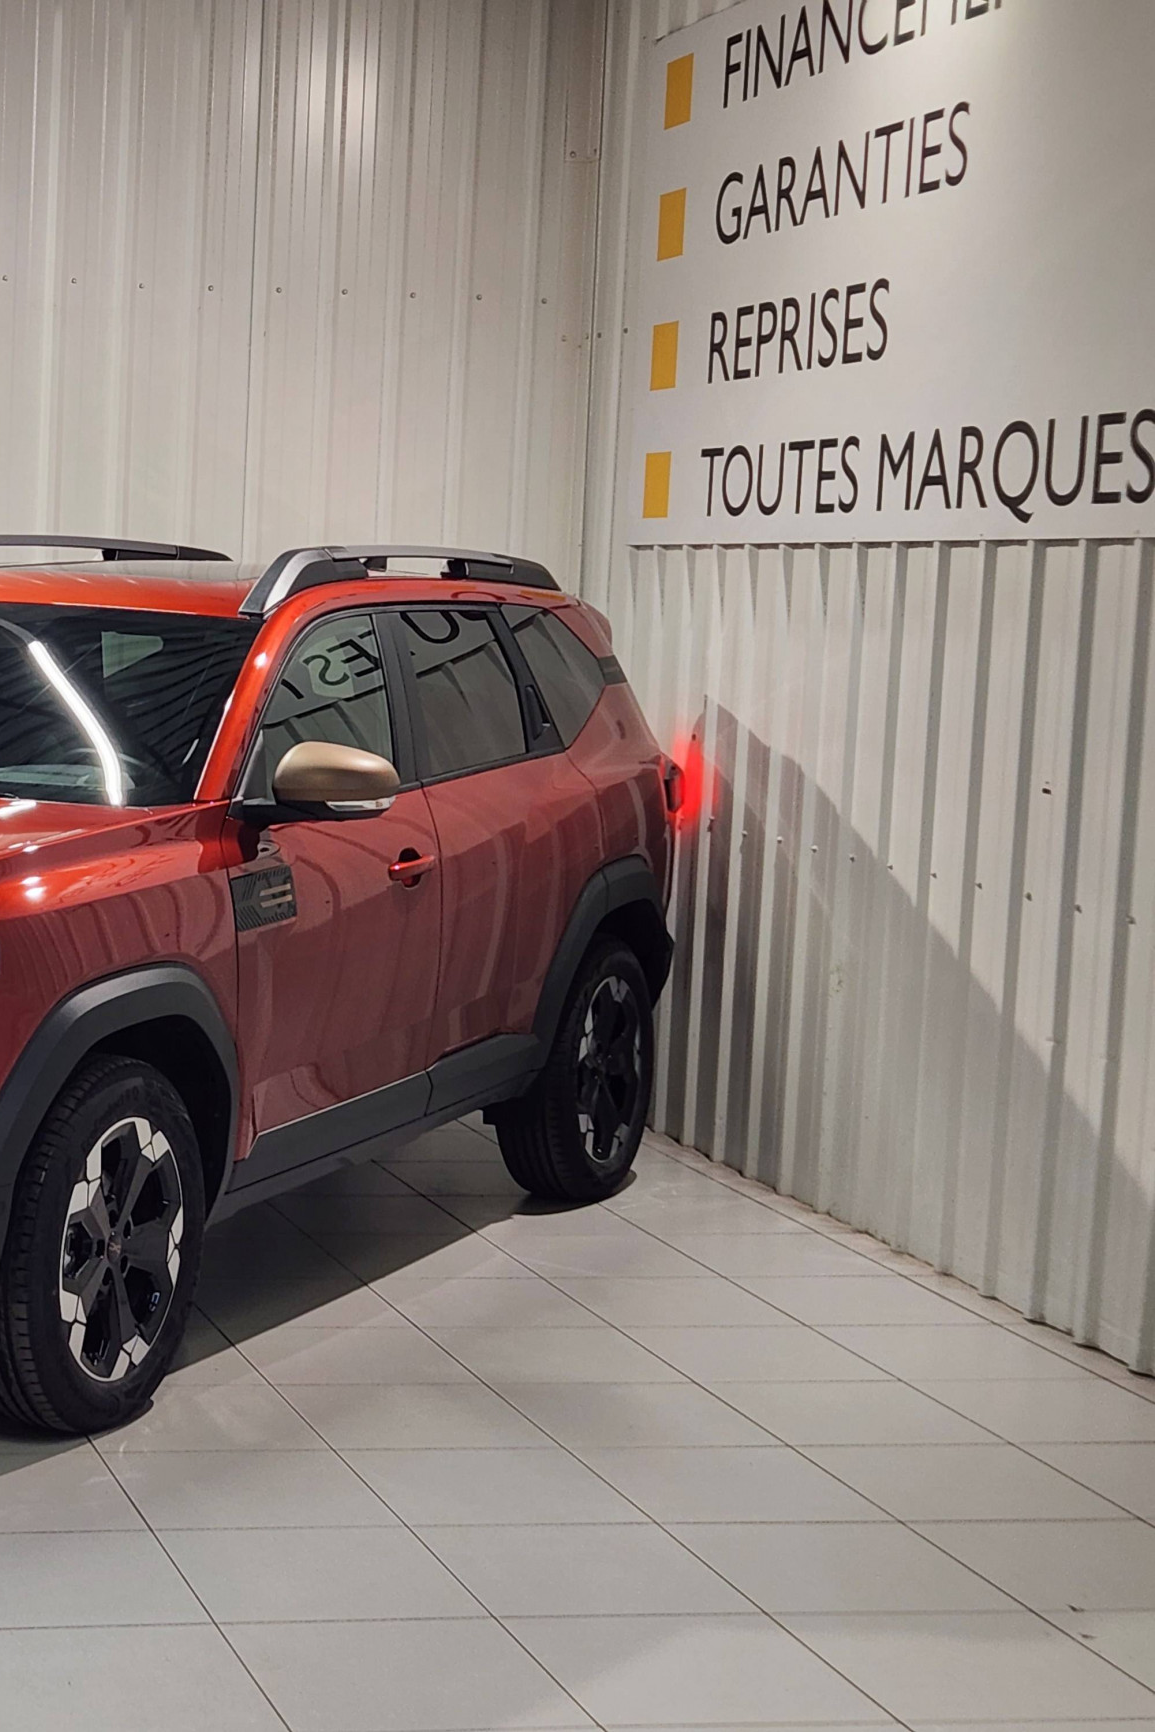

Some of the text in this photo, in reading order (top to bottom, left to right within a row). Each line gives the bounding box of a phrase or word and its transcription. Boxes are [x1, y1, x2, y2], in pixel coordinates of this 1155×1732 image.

[715, 101, 971, 245] GARANTIES
[707, 278, 890, 384] REPRISES
[700, 408, 1155, 524] TOUTES MARQUES
